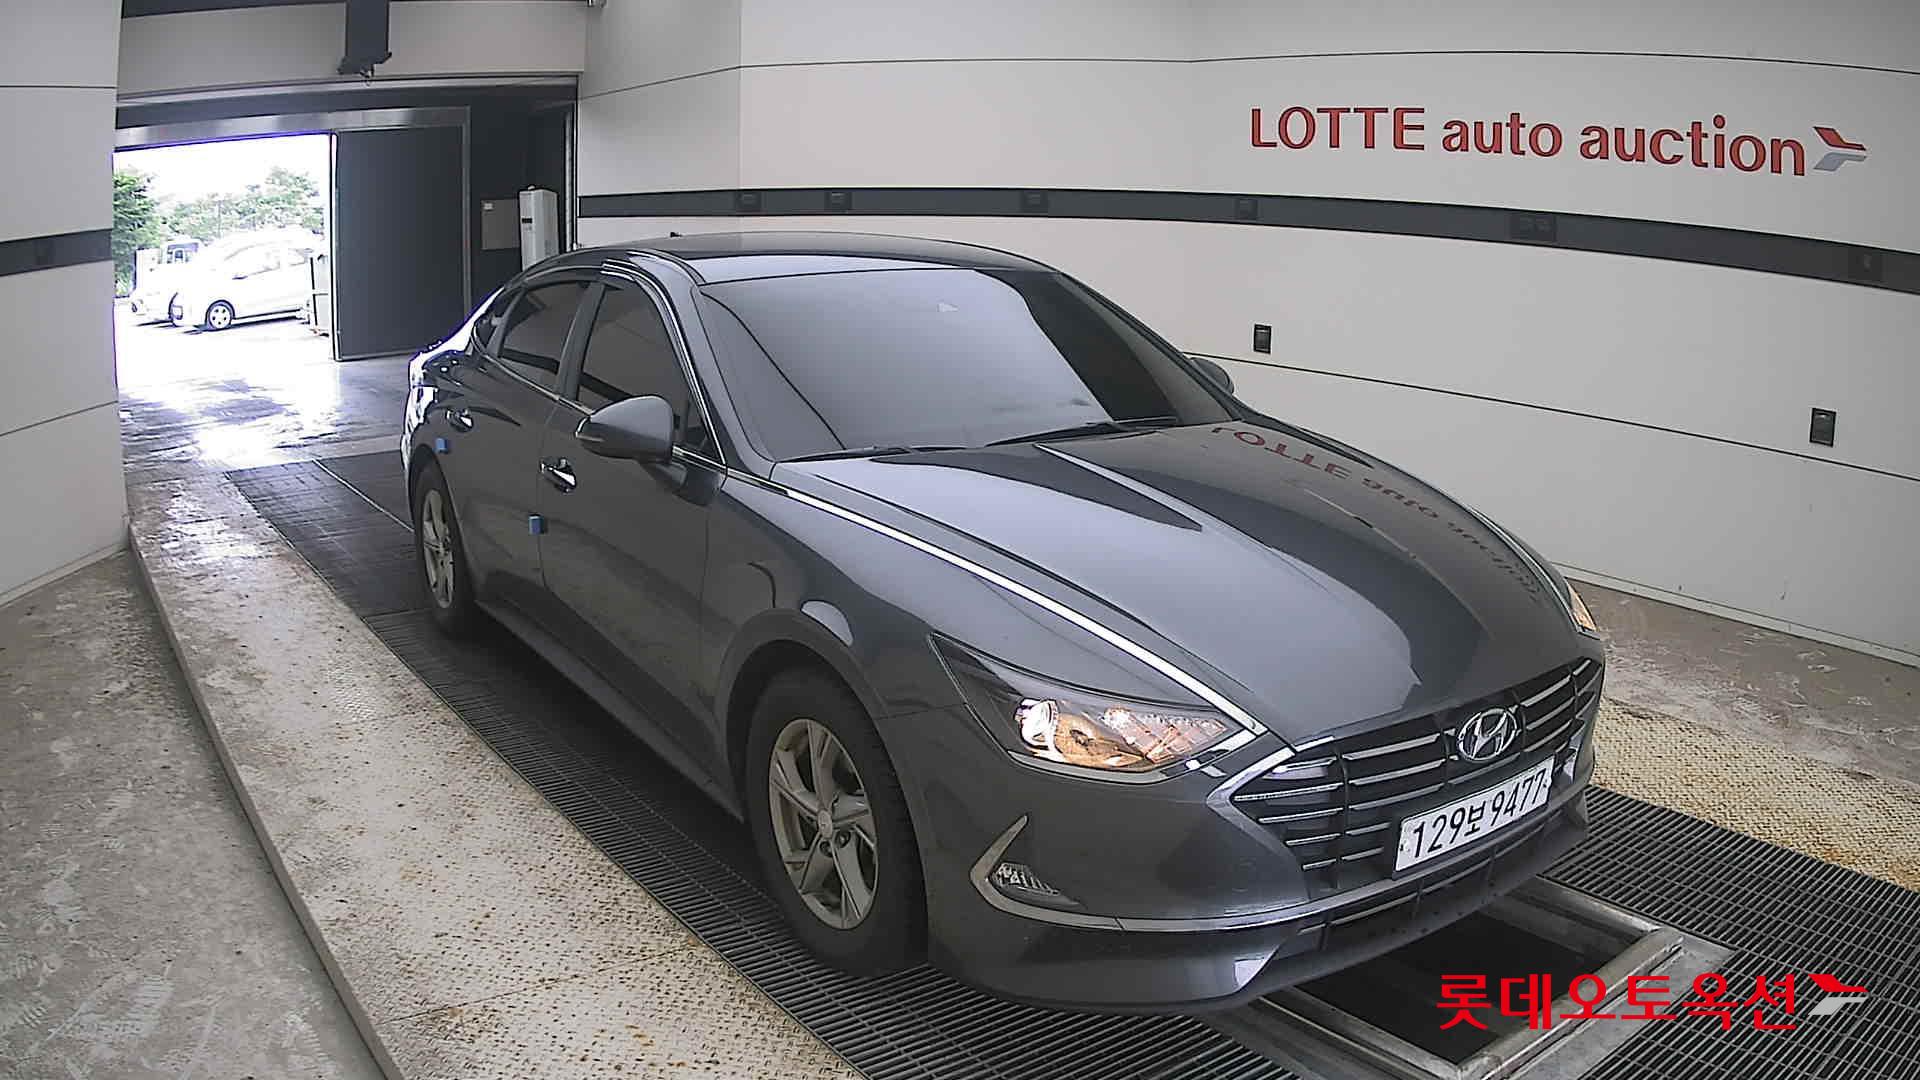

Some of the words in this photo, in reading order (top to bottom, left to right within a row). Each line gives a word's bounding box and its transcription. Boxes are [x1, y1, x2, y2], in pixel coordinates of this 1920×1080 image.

[1250, 107, 1425, 150] LOTTE
[1442, 112, 1563, 158] auto
[1580, 114, 1805, 177] auction
[1413, 800, 1485, 858] 129보
[1490, 768, 1547, 827] 9477
